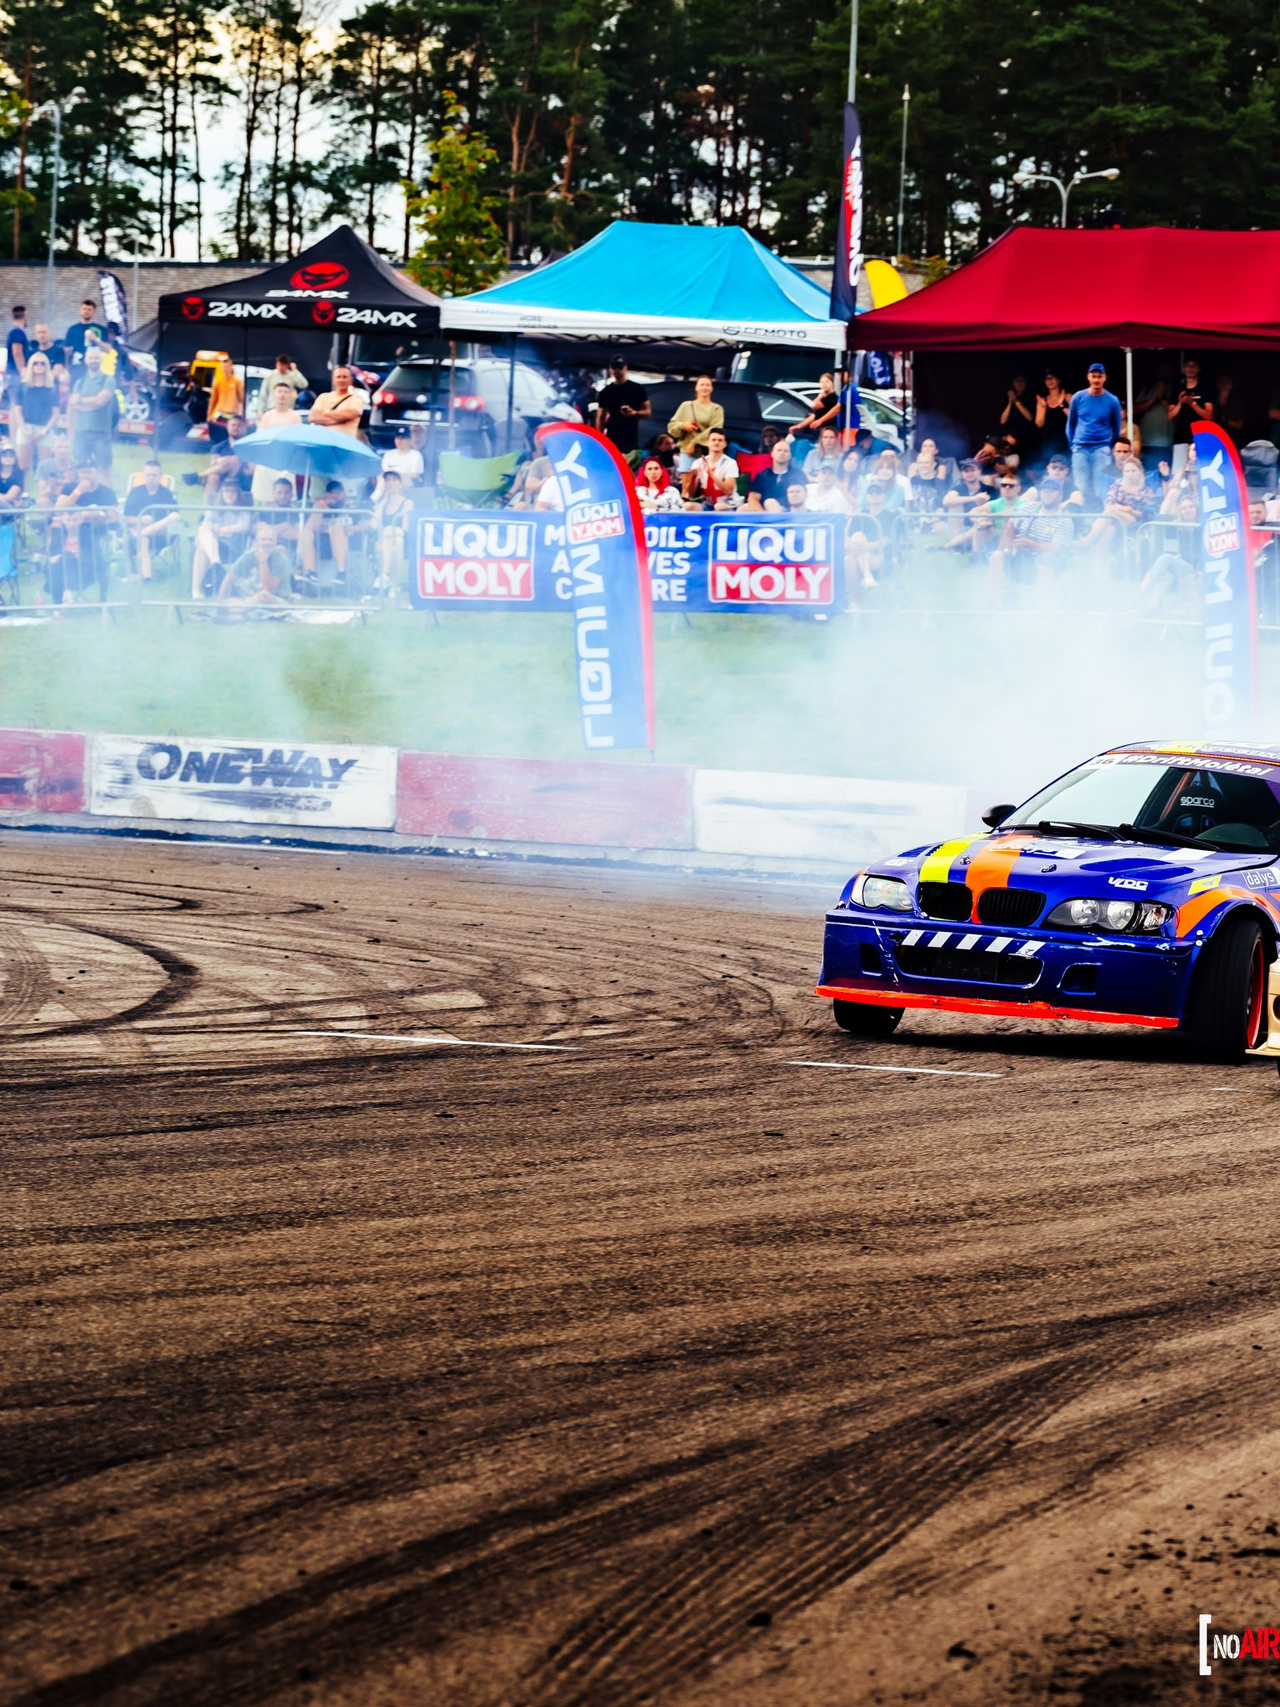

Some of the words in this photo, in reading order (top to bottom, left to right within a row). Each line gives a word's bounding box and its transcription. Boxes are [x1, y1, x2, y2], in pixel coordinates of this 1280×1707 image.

[207, 302, 287, 320] 24MX
[336, 307, 417, 328] 24MX
[423, 522, 529, 559] LIQUI
[716, 527, 827, 563] LIQUI
[423, 560, 532, 597] MOLY
[716, 563, 831, 600] MOLY
[1121, 753, 1275, 777] #DriftMolétal
[1180, 796, 1215, 806] sparco
[1246, 868, 1275, 887] dalys
